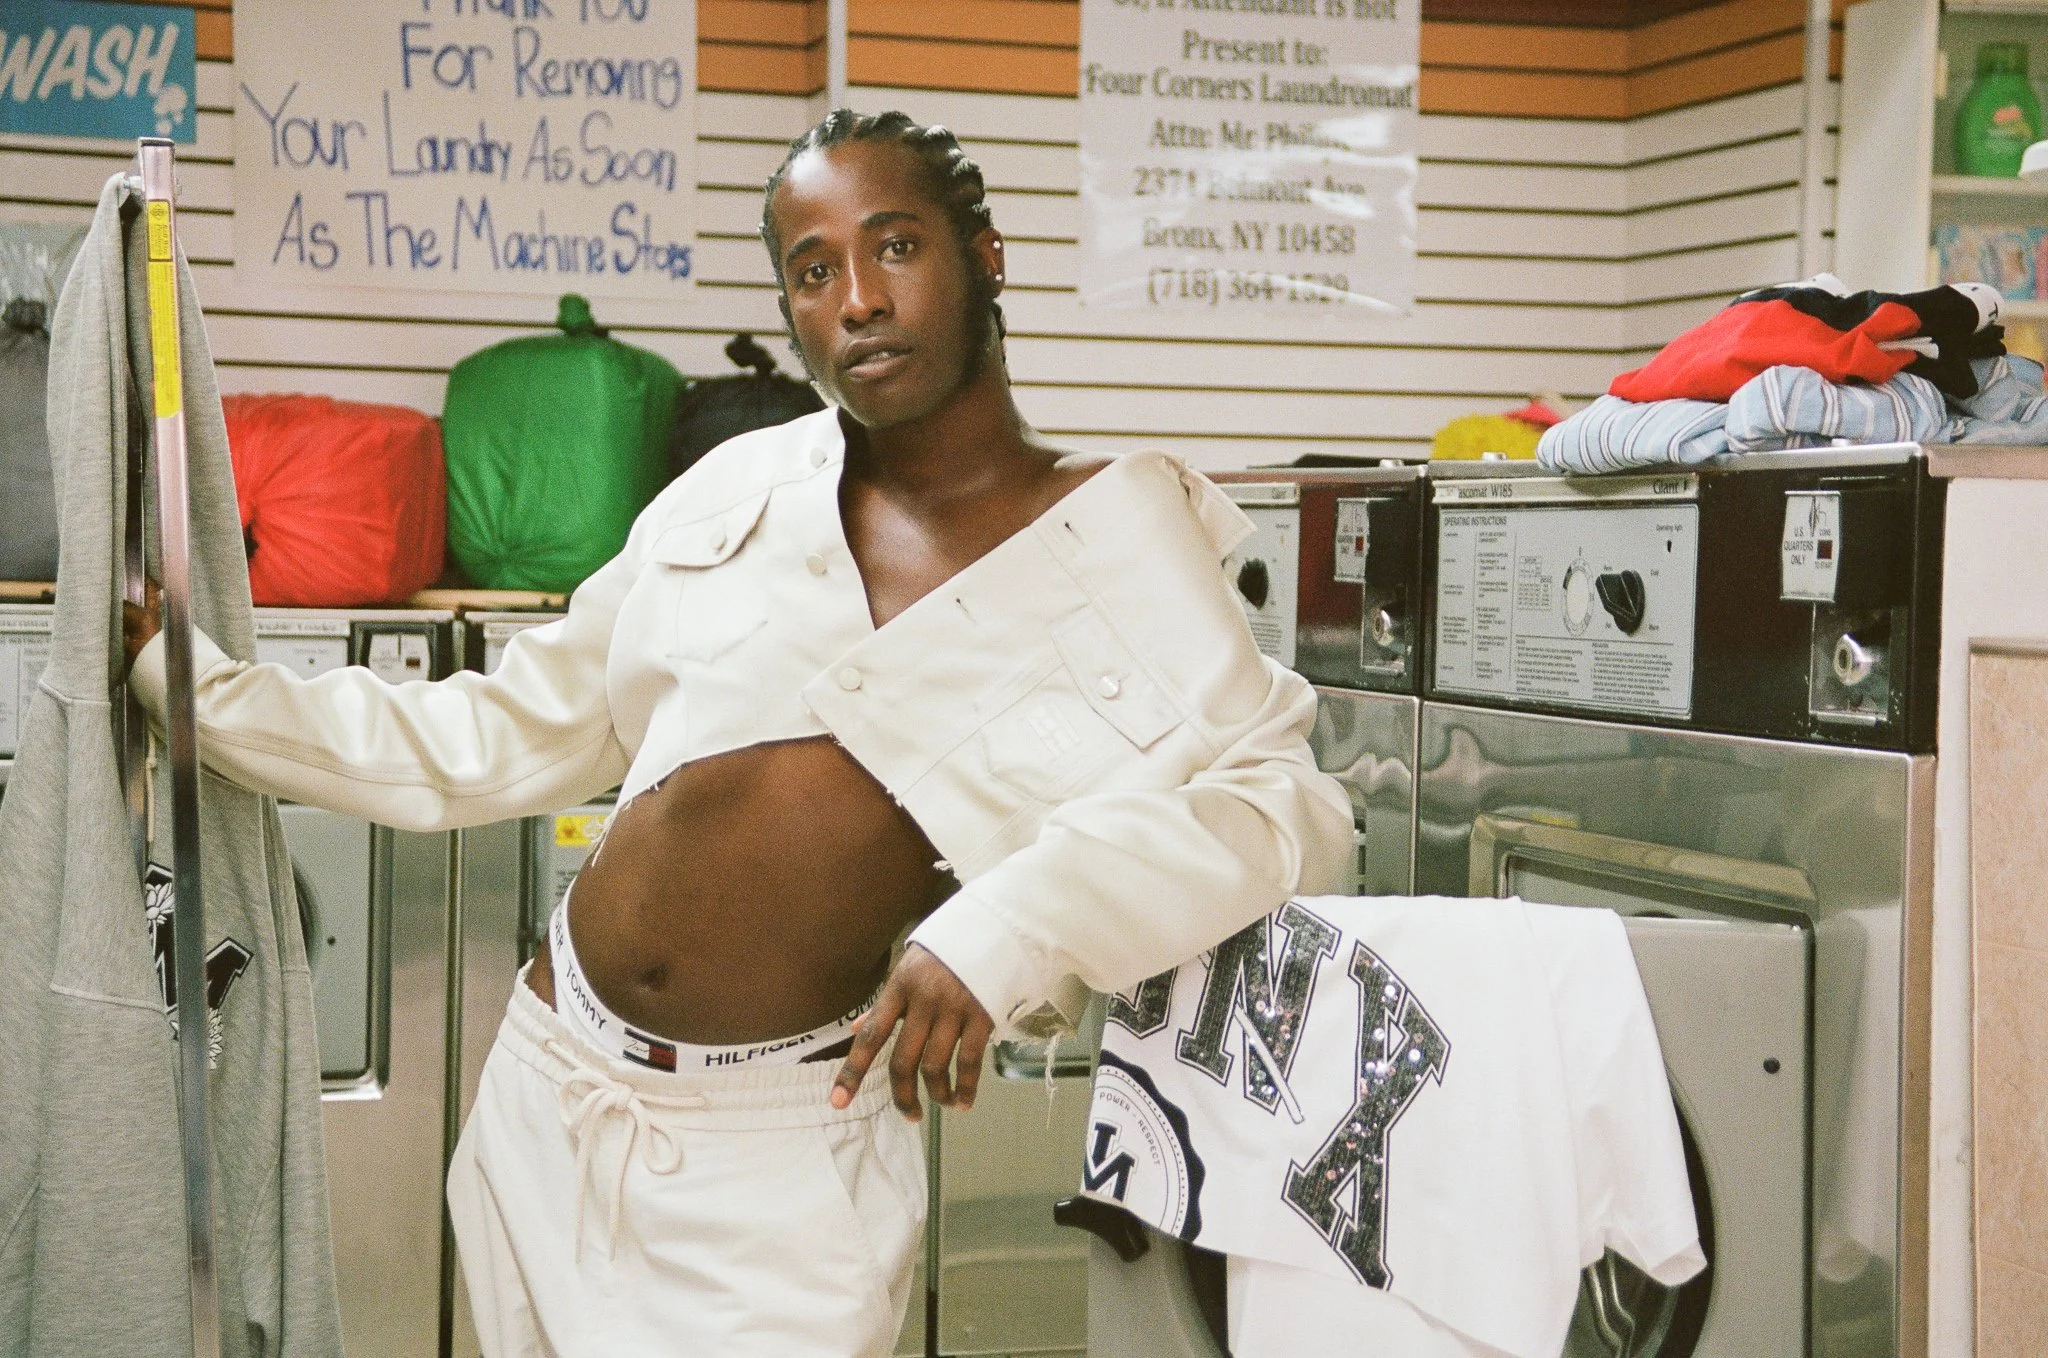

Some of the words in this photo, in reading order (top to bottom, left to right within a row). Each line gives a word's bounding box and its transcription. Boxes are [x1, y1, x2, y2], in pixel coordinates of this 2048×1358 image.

[421, 0, 554, 19] ank
[0, 21, 180, 103] WASH
[400, 22, 493, 91] For
[1182, 29, 1287, 65] Present
[1085, 62, 1147, 96] Four
[1152, 66, 1255, 101] Corners
[1259, 72, 1413, 108] Laundromat
[240, 82, 366, 170] Your
[522, 115, 574, 184] As
[580, 110, 678, 192] Soon
[273, 194, 340, 271] As
[346, 191, 442, 270] The
[452, 195, 607, 273] Machine
[1143, 217, 1225, 253] Bronx,
[1232, 220, 1269, 252] NY
[1277, 223, 1357, 255] 10458
[1147, 266, 1219, 306] (718)
[1458, 486, 1488, 499] ascomat
[1444, 516, 1470, 526] OPERATING
[1471, 515, 1507, 526] INSTRUCTIONS
[1784, 539, 1814, 552] QUARTERS
[566, 959, 608, 1031] TOMMY
[1099, 1091, 1132, 1112] POWER
[1138, 1119, 1161, 1165] RESPECT
